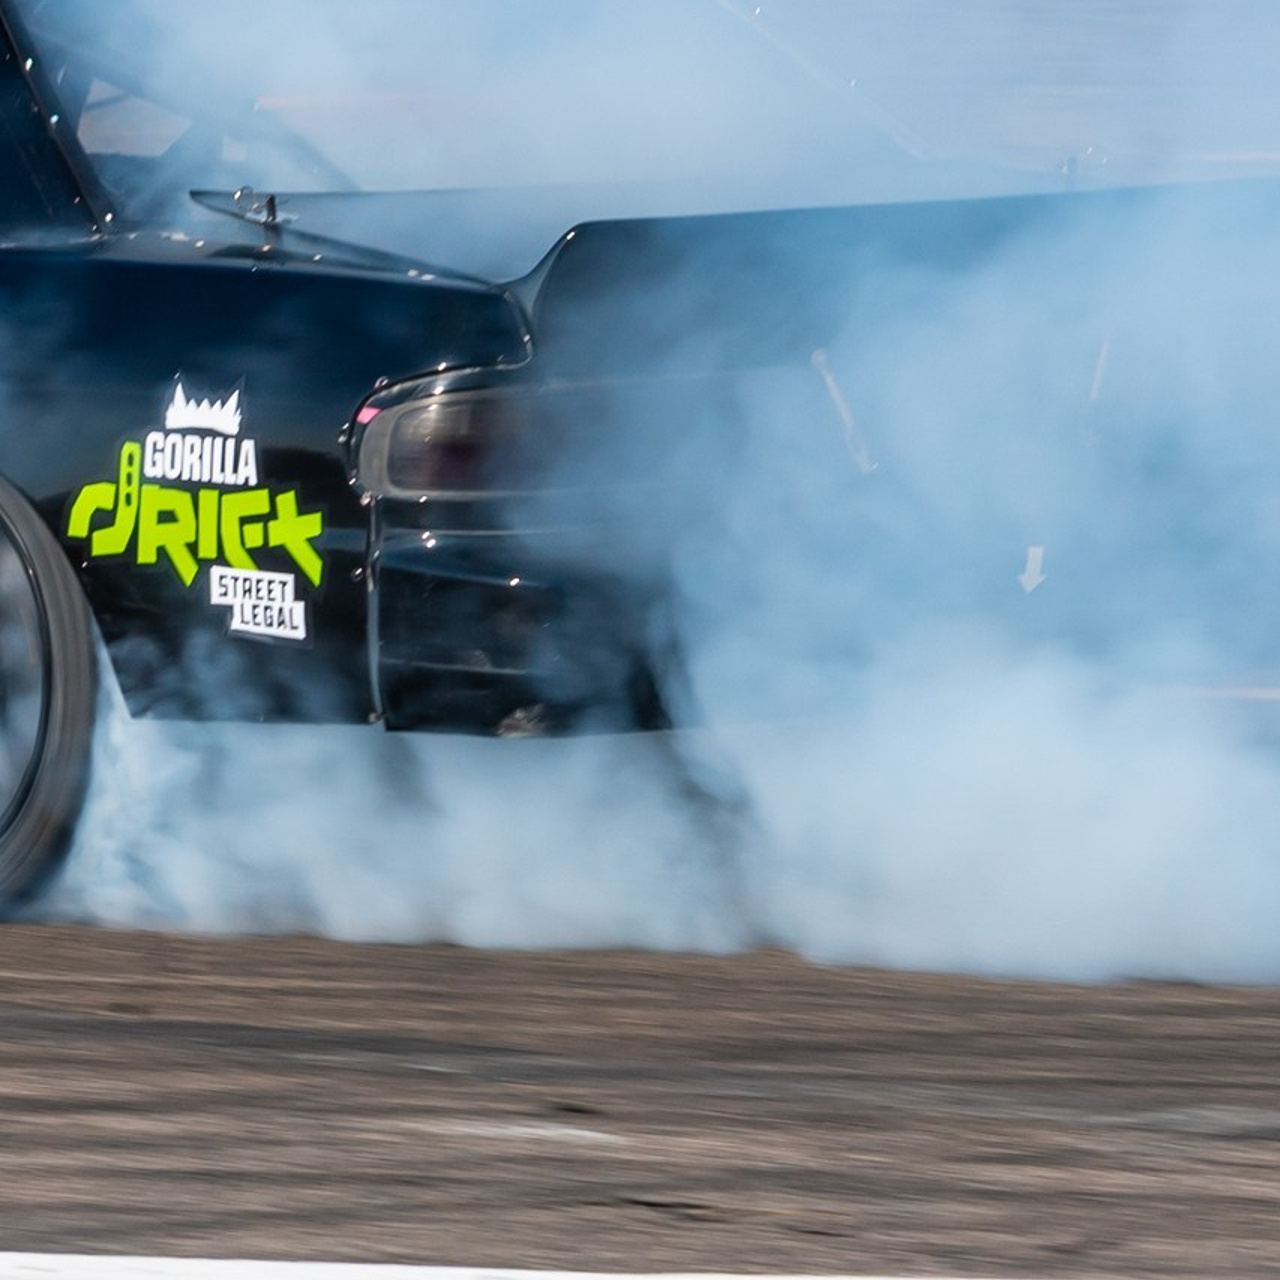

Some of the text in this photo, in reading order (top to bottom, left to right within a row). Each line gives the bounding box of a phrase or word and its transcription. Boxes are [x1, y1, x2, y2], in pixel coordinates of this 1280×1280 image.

[144, 432, 258, 486] GORILLA
[219, 574, 288, 602] STREET
[240, 603, 300, 630] LEGAL
